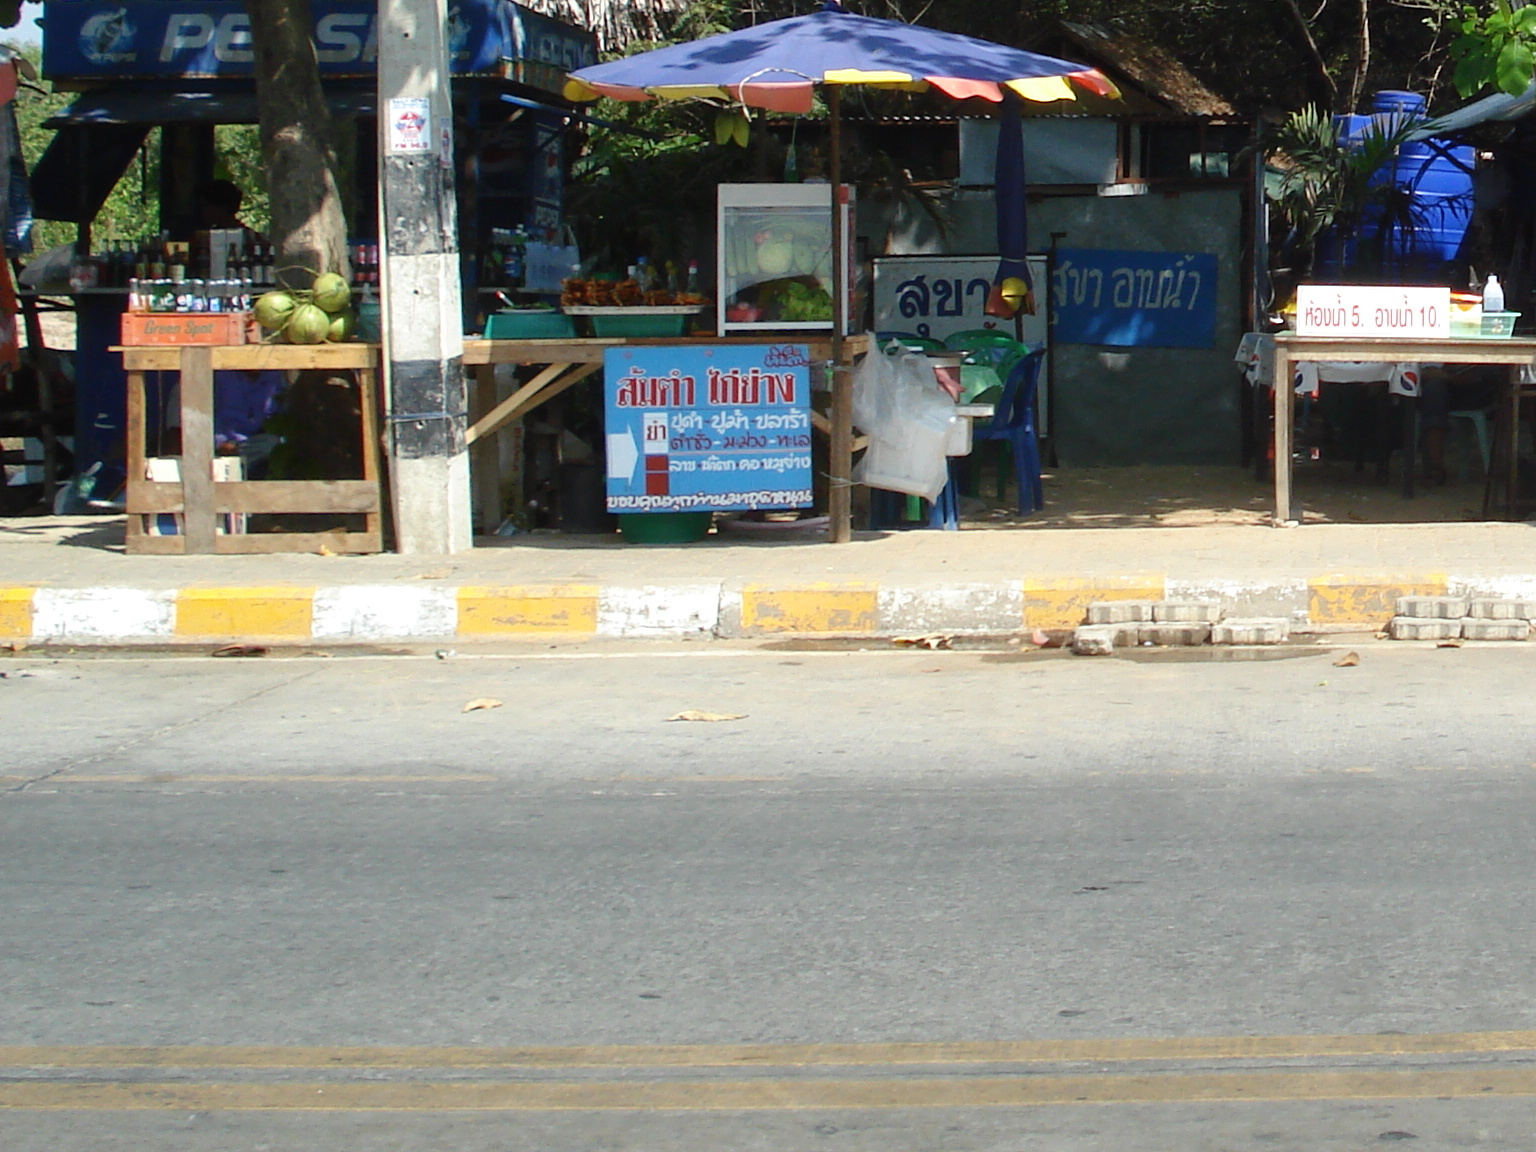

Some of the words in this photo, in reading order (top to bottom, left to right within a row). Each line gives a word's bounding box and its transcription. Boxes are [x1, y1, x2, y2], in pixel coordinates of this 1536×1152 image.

[159, 13, 378, 63] PESI
[144, 319, 181, 335] Green
[184, 318, 215, 338] Spot
[1305, 294, 1346, 328] ห้องน้ำ
[1352, 305, 1364, 328] 5.
[1375, 294, 1414, 328] อาบน้ำ
[1419, 305, 1441, 328] 10.
[617, 366, 696, 408] ส้มตำ
[707, 367, 797, 406] ไก่ย่าง
